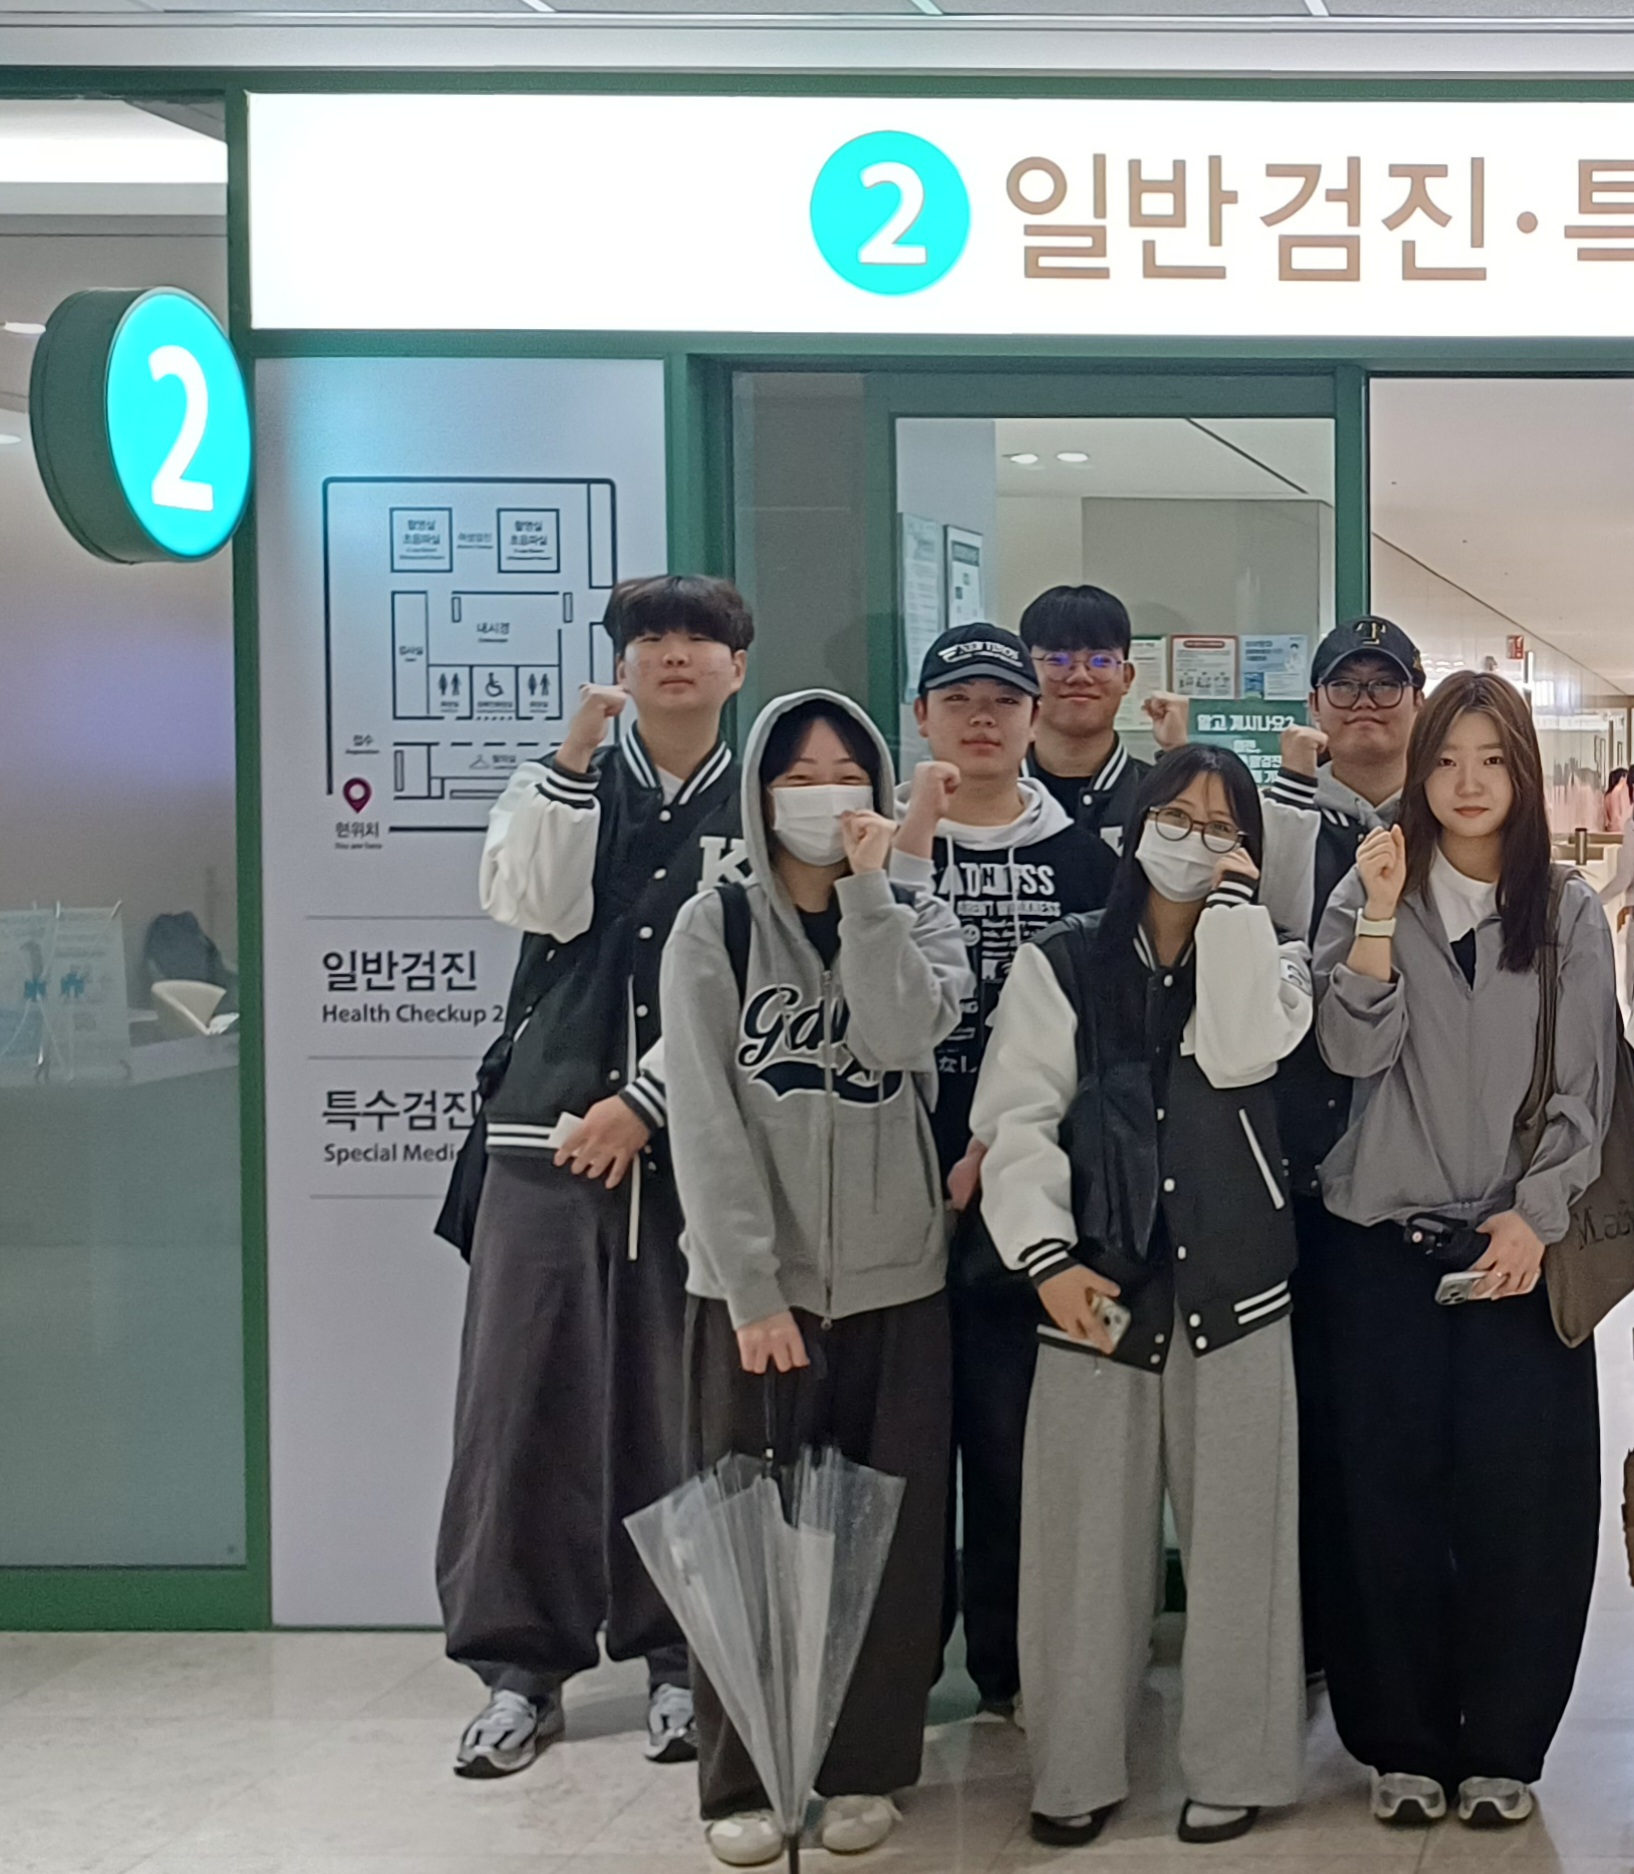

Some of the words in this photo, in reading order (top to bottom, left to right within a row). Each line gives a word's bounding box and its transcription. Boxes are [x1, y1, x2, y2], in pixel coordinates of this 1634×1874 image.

[861, 164, 925, 263] 2
[148, 346, 214, 512] 2
[335, 822, 380, 839] 현위치
[697, 836, 751, 891] K
[322, 949, 478, 992] 일반검진
[322, 1003, 390, 1023] Health
[396, 1003, 487, 1026] Checkup
[492, 1005, 505, 1023] 2
[322, 1089, 480, 1132] 특수검진
[324, 1143, 397, 1166] Special
